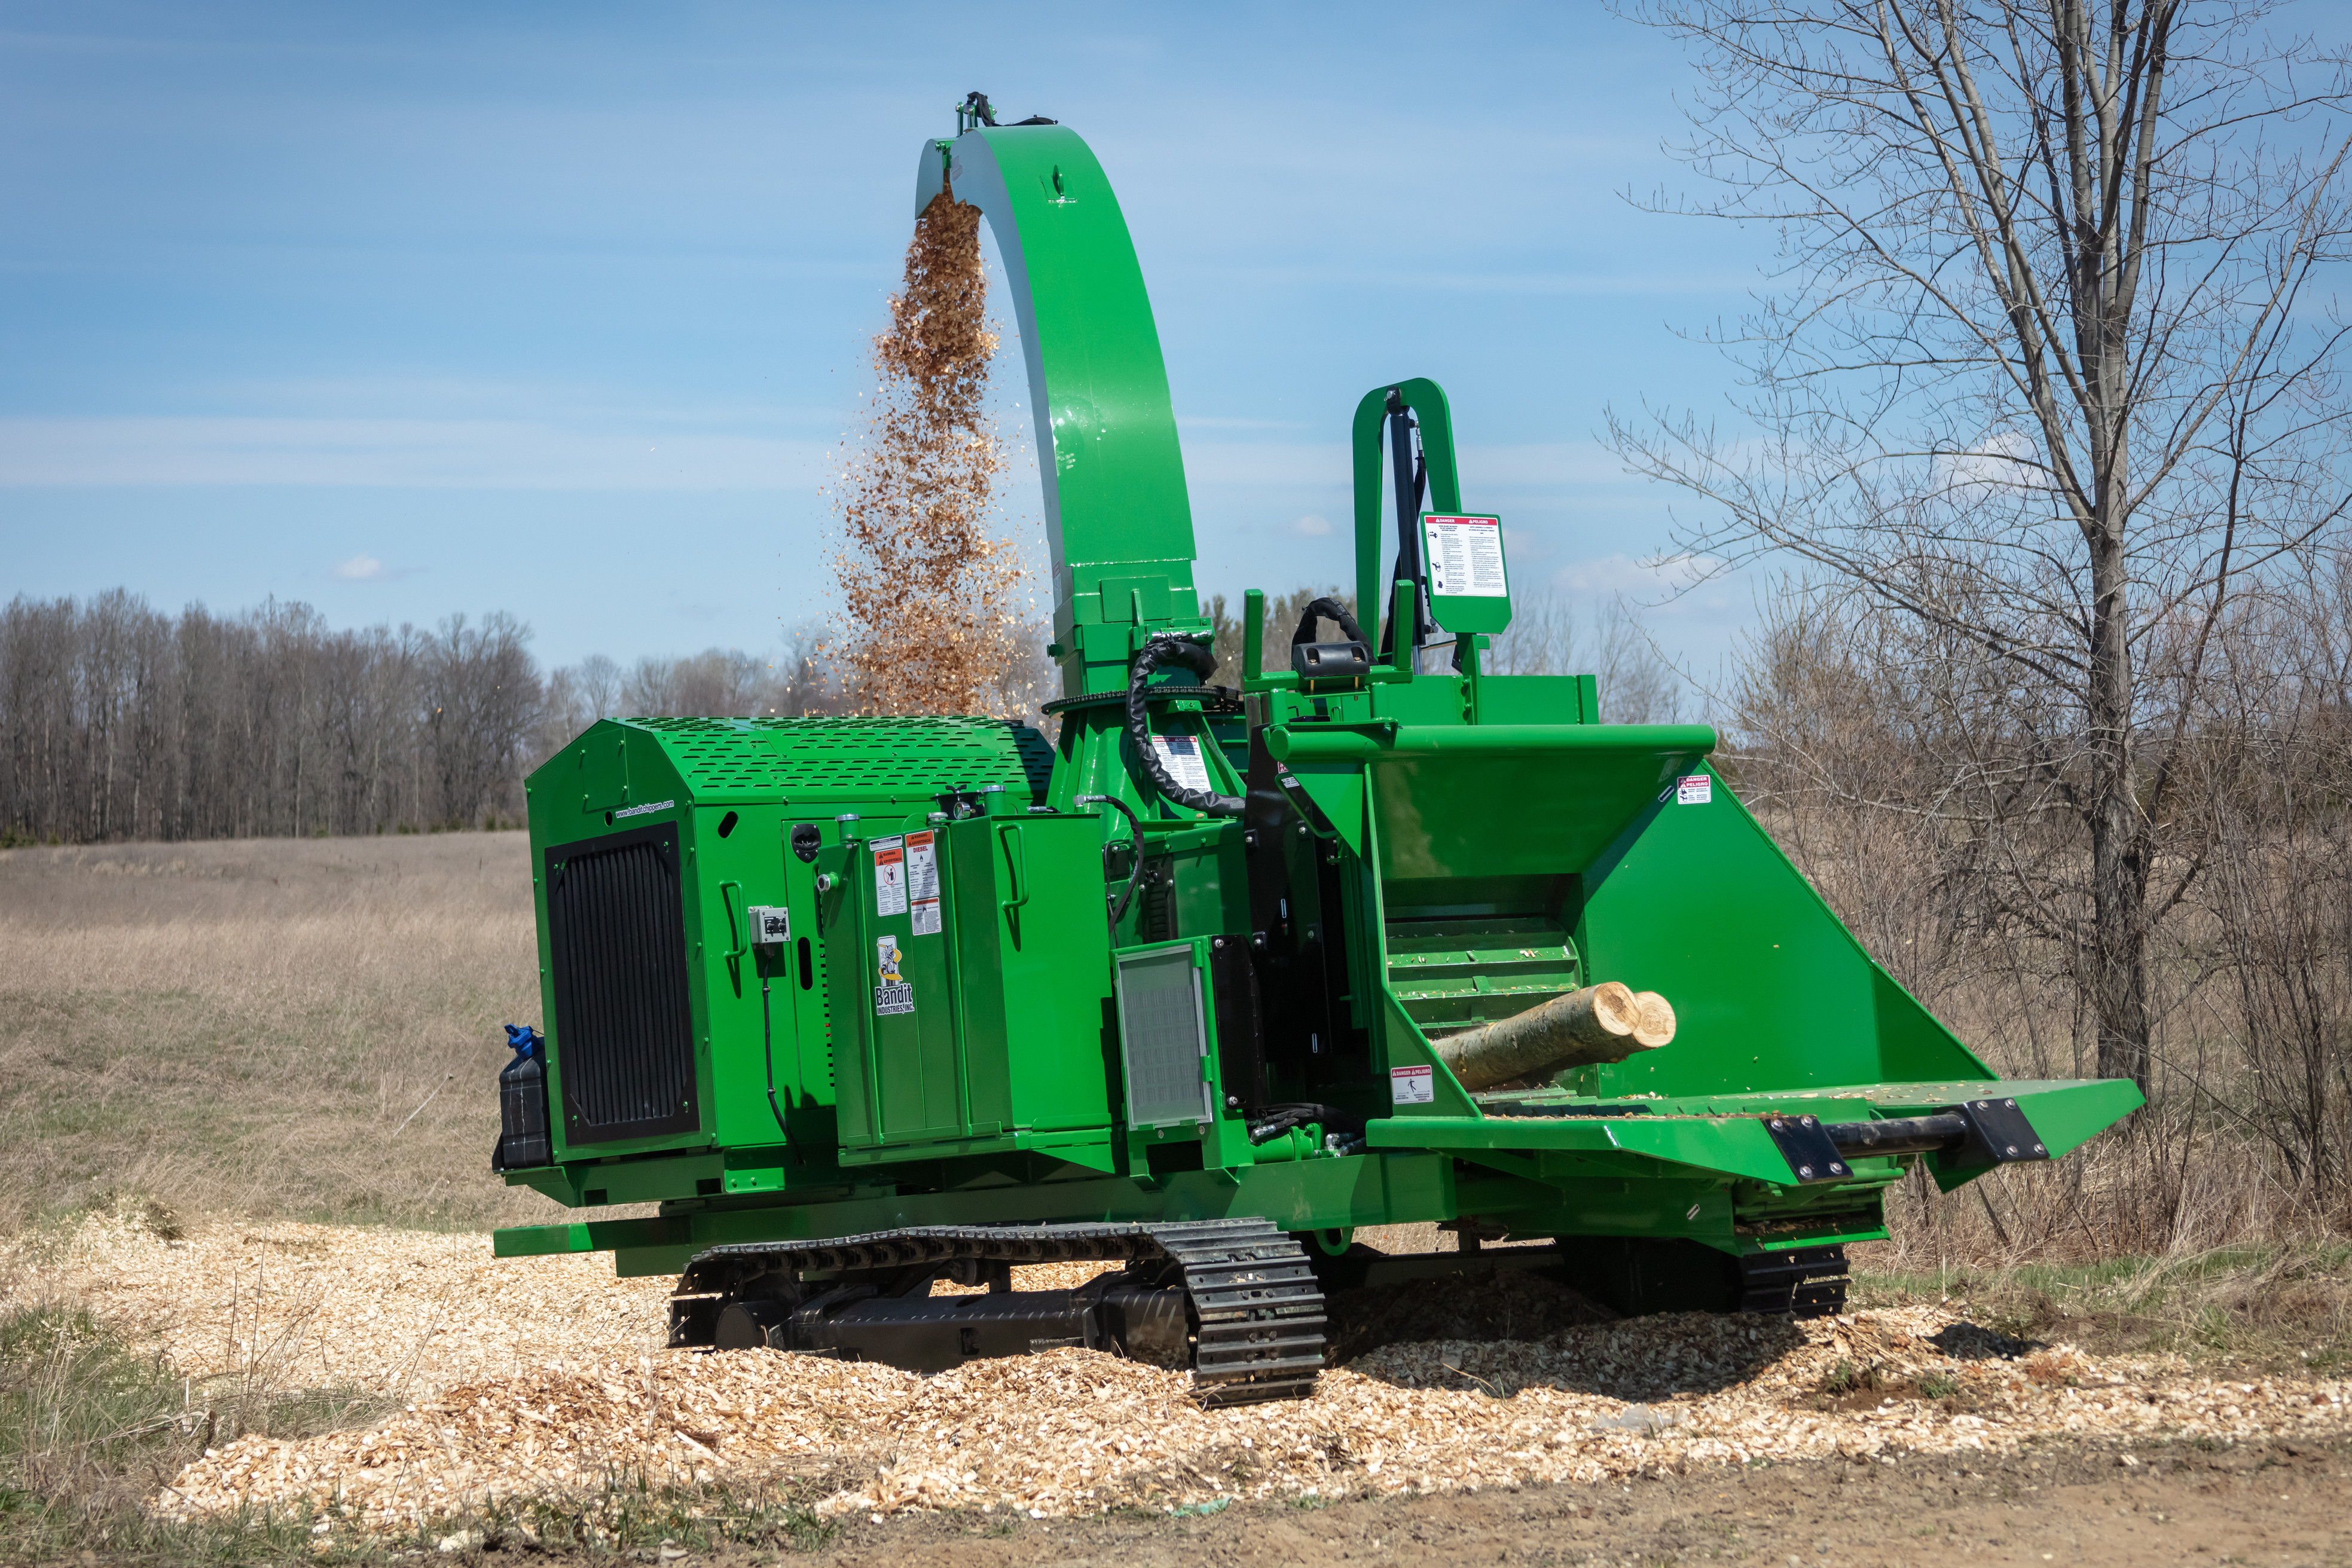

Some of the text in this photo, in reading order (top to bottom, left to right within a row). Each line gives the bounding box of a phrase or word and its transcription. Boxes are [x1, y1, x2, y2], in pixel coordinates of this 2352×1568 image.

[616, 800, 674, 818] www.banditchippers.com
[875, 984, 912, 1006] Bandit
[877, 1005, 905, 1014] INDUSTRIES,
